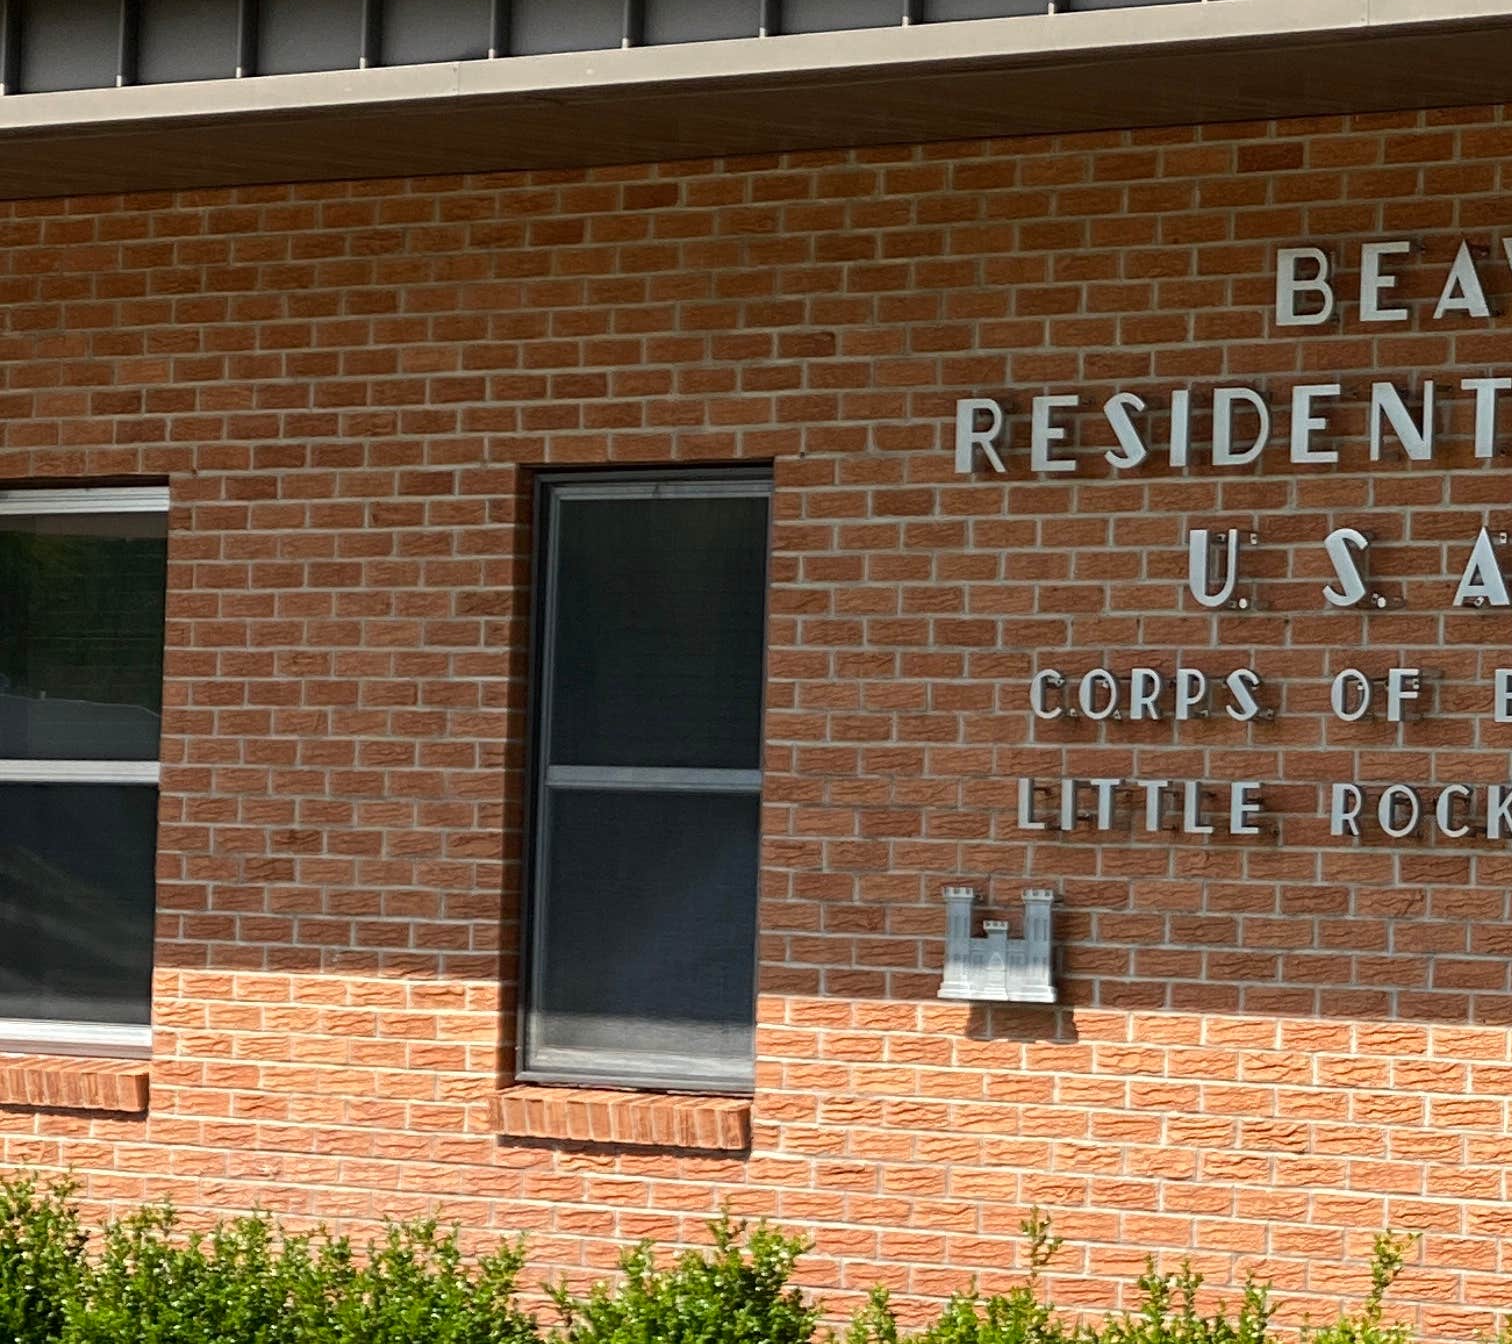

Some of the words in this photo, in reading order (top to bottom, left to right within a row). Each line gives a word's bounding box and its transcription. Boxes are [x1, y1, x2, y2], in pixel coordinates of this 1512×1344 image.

[1030, 667, 1261, 722] CORPS
[1331, 667, 1420, 722] OF
[1018, 777, 1262, 834] LITTLE
